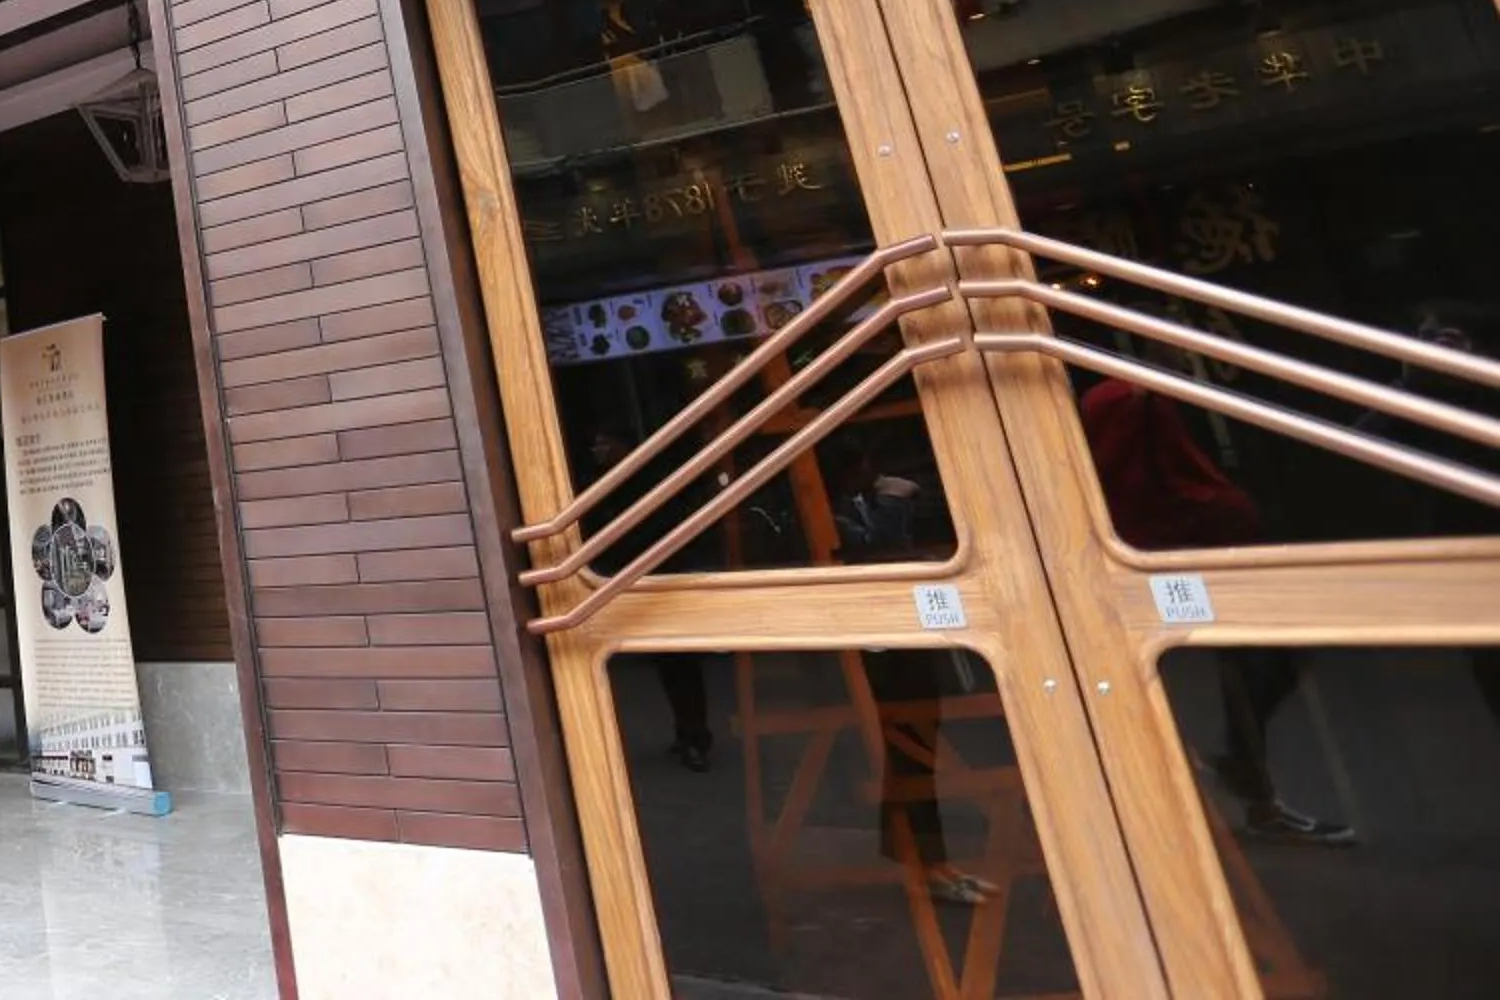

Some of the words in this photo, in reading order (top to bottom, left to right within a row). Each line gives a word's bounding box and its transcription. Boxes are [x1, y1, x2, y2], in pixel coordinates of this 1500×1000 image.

[1163, 577, 1195, 604] 推
[925, 589, 950, 611] 推
[925, 612, 960, 625] PUSH
[1165, 604, 1206, 619] PUSH
